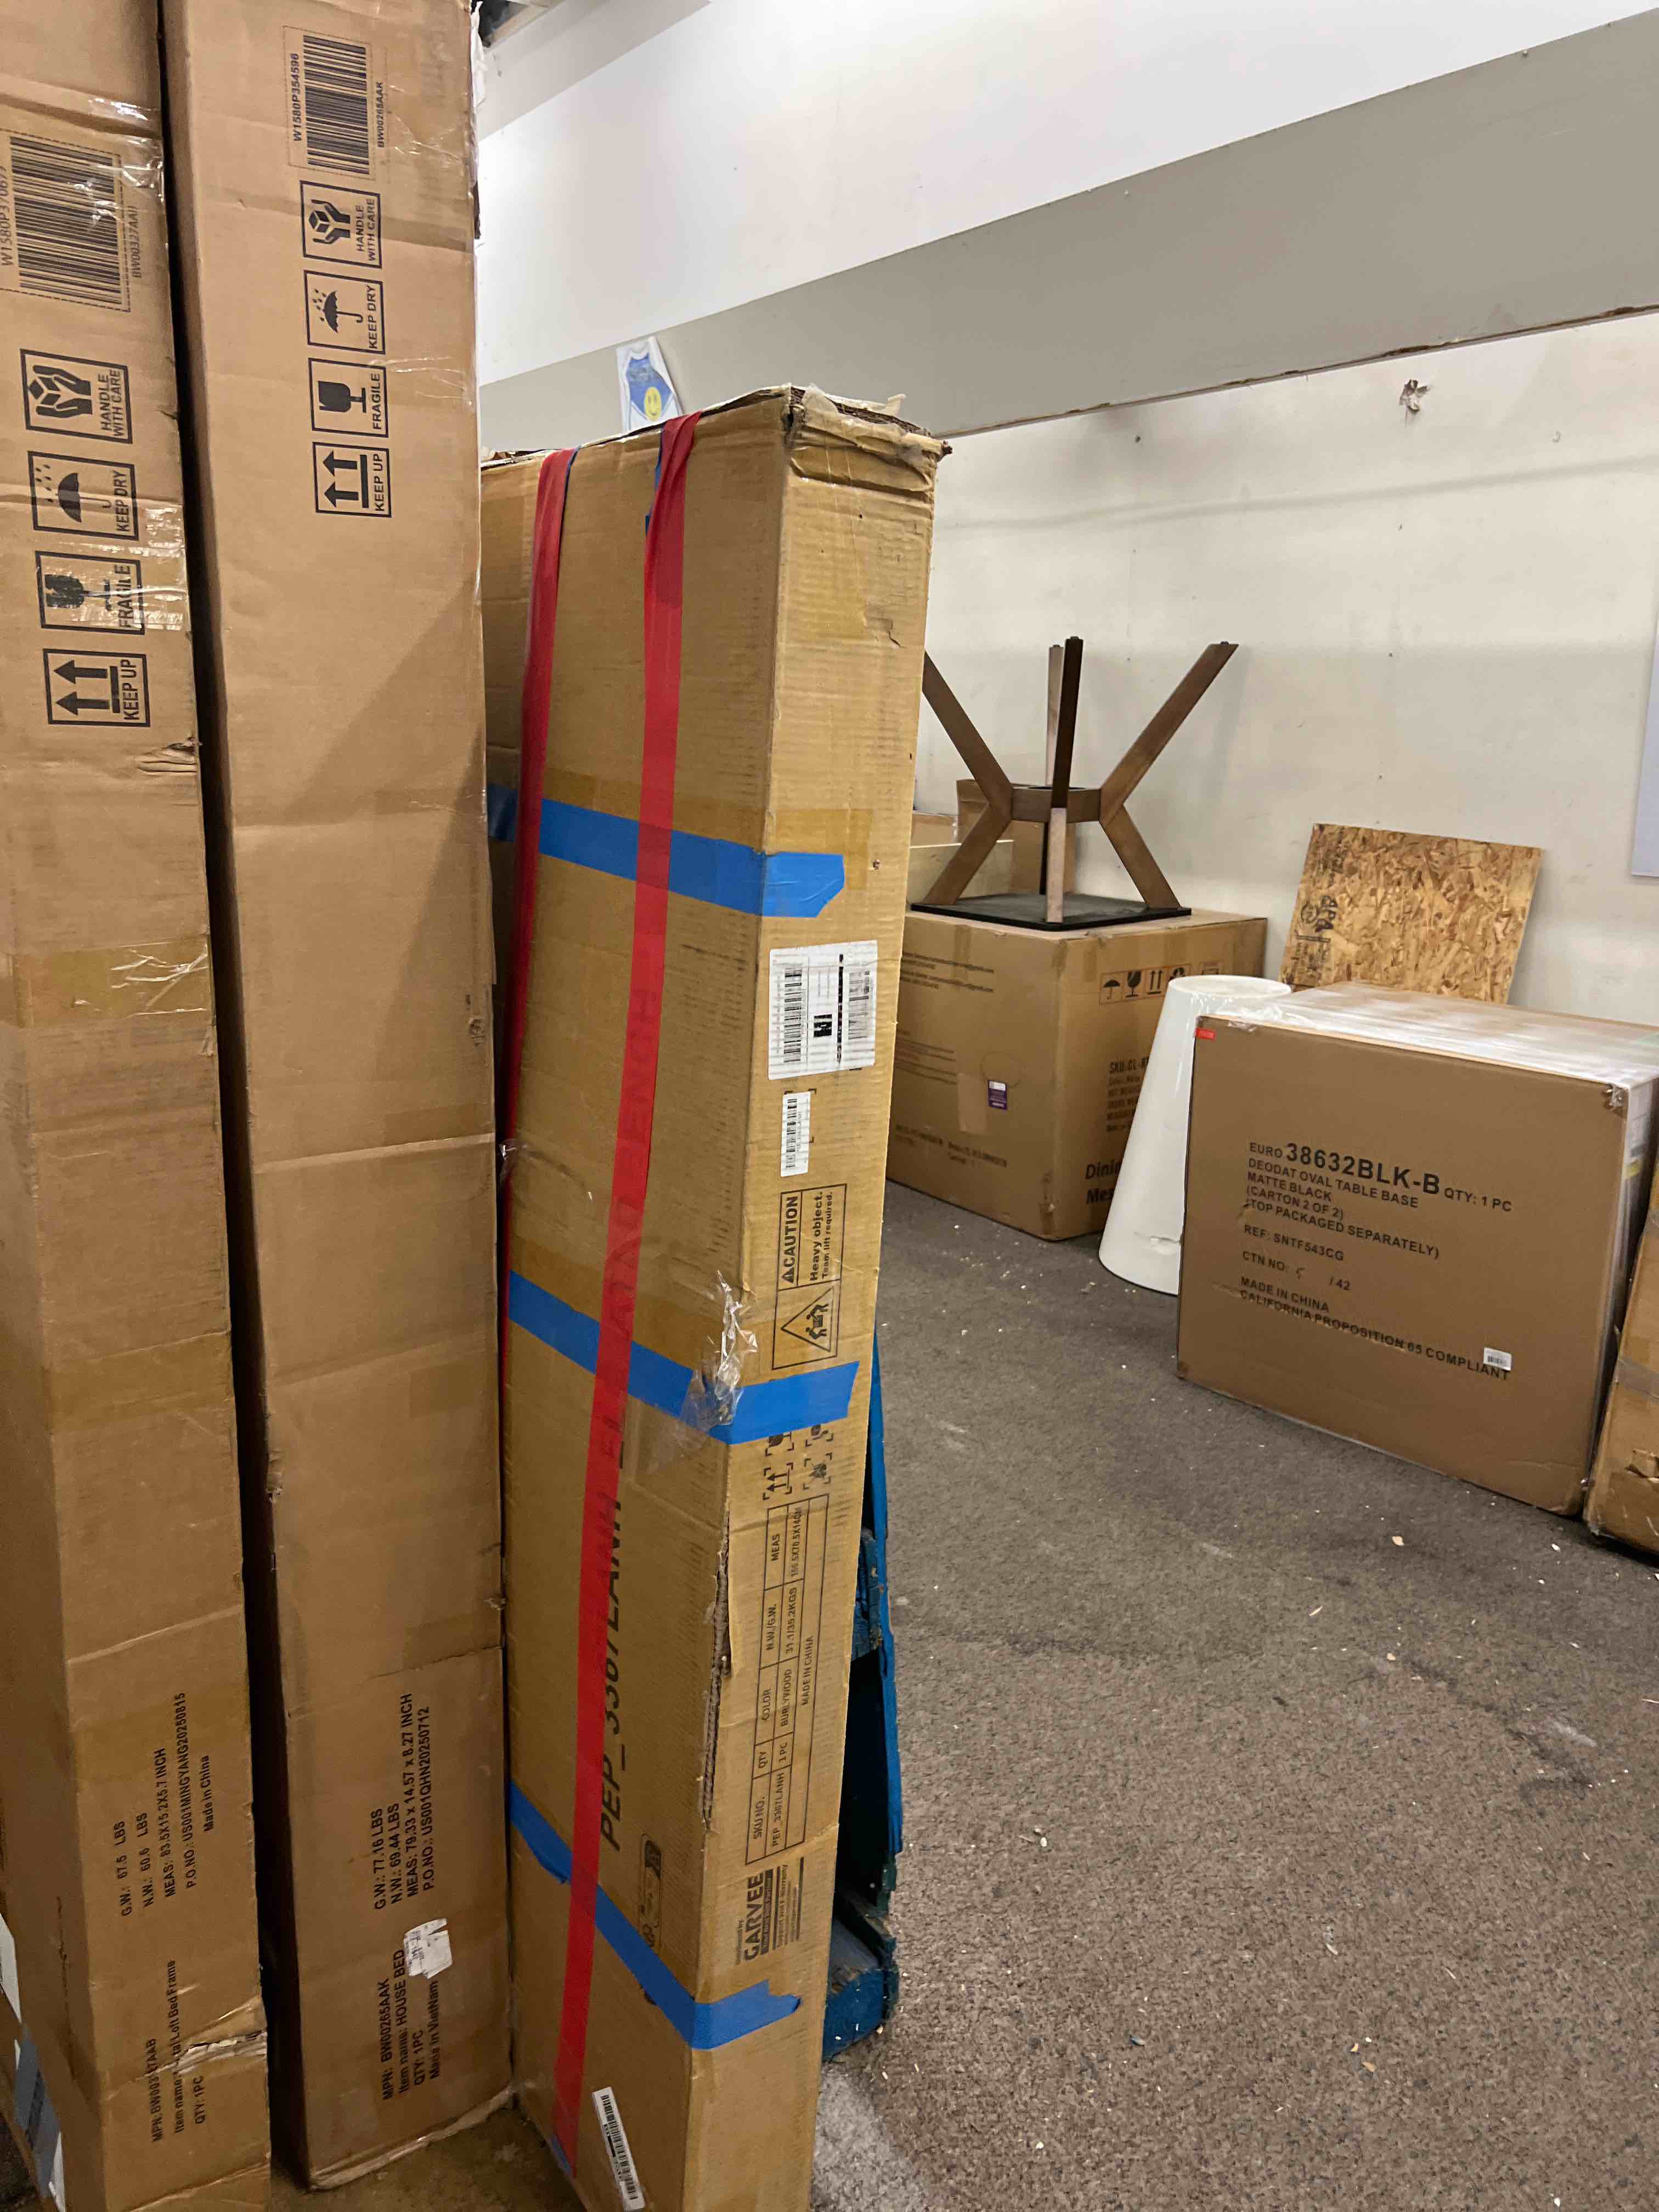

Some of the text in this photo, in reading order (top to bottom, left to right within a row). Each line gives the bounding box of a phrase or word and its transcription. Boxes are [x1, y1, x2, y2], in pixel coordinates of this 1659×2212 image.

[290, 53, 302, 141] W1580P354596
[356, 205, 365, 251] HANDLE
[366, 198, 377, 262] WITH CARE
[366, 285, 378, 349] KEEP DRY
[97, 375, 110, 430] HANDLE
[110, 369, 124, 438] WITH CARE
[371, 373, 382, 431] FRAGILE
[114, 470, 130, 532] KEEP DRY
[373, 453, 385, 512] KEEP UP
[120, 658, 139, 720] KEEP UP
[1248, 1158, 1418, 1208] DEODAT OVAL TABLE BASE
[1248, 1171, 1332, 1203] MATTE BLACK
[1249, 1142, 1512, 1212] EURO 38632BLK-B QTY: 1 PC
[1246, 1186, 1344, 1221] (CARTON 2 OF 2)
[783, 1196, 798, 1267] CAUTION
[810, 1191, 823, 1281] Heavy object.
[1244, 1224, 1270, 1240] REF:
[1276, 1205, 1344, 1233] PACKAGED
[1347, 1225, 1440, 1260] SEPARATELY)
[1243, 1251, 1265, 1266] CTN
[1241, 1276, 1329, 1313] MADE IN CHINA
[1240, 1290, 1511, 1380] CALIFORNIA PROPOSITION 65 COMPLIANT
[771, 1534, 781, 1561] MEAS
[766, 1604, 777, 1650] N.W./G.W.
[802, 1635, 814, 1706] MADE IN CHINA
[400, 1694, 413, 1728] INCH
[762, 1689, 772, 1720] COLOR
[781, 1669, 792, 1726] BURLYWOOD
[154, 1748, 167, 1778] INCH
[402, 1732, 413, 1754] 8.27
[758, 1751, 768, 1768] QTY
[780, 1741, 788, 1754] PC
[199, 1756, 215, 1831] Made in China
[403, 1771, 414, 1804] 14.57
[114, 1821, 126, 1846] LBS
[137, 1813, 148, 1838] LBS
[405, 1818, 416, 1851] 79.33
[753, 1797, 765, 1837] SKU NO.
[371, 1809, 386, 1909] G.W.: 77.16 LBS
[387, 1803, 402, 1904] N.W.: 69.44 LBS
[407, 1854, 417, 1897] MEAS:
[141, 1877, 154, 1907] N.W.:
[163, 1859, 176, 1897] MEAS:
[119, 1887, 132, 1916] G.W.:
[744, 1872, 764, 1962] GARVEE
[166, 1961, 177, 1995] Frame
[167, 1997, 178, 2016] Bed
[168, 2017, 180, 2039] Loft
[393, 1950, 409, 2094] Item name: HOUSE BED
[377, 1978, 393, 2100] MPN: BW00265AAK
[413, 2030, 425, 2085] QTY: 1PC
[430, 2049, 440, 2079] Made
[193, 2076, 205, 2124] QTY: 1PC
[151, 2114, 162, 2142] MPN:
